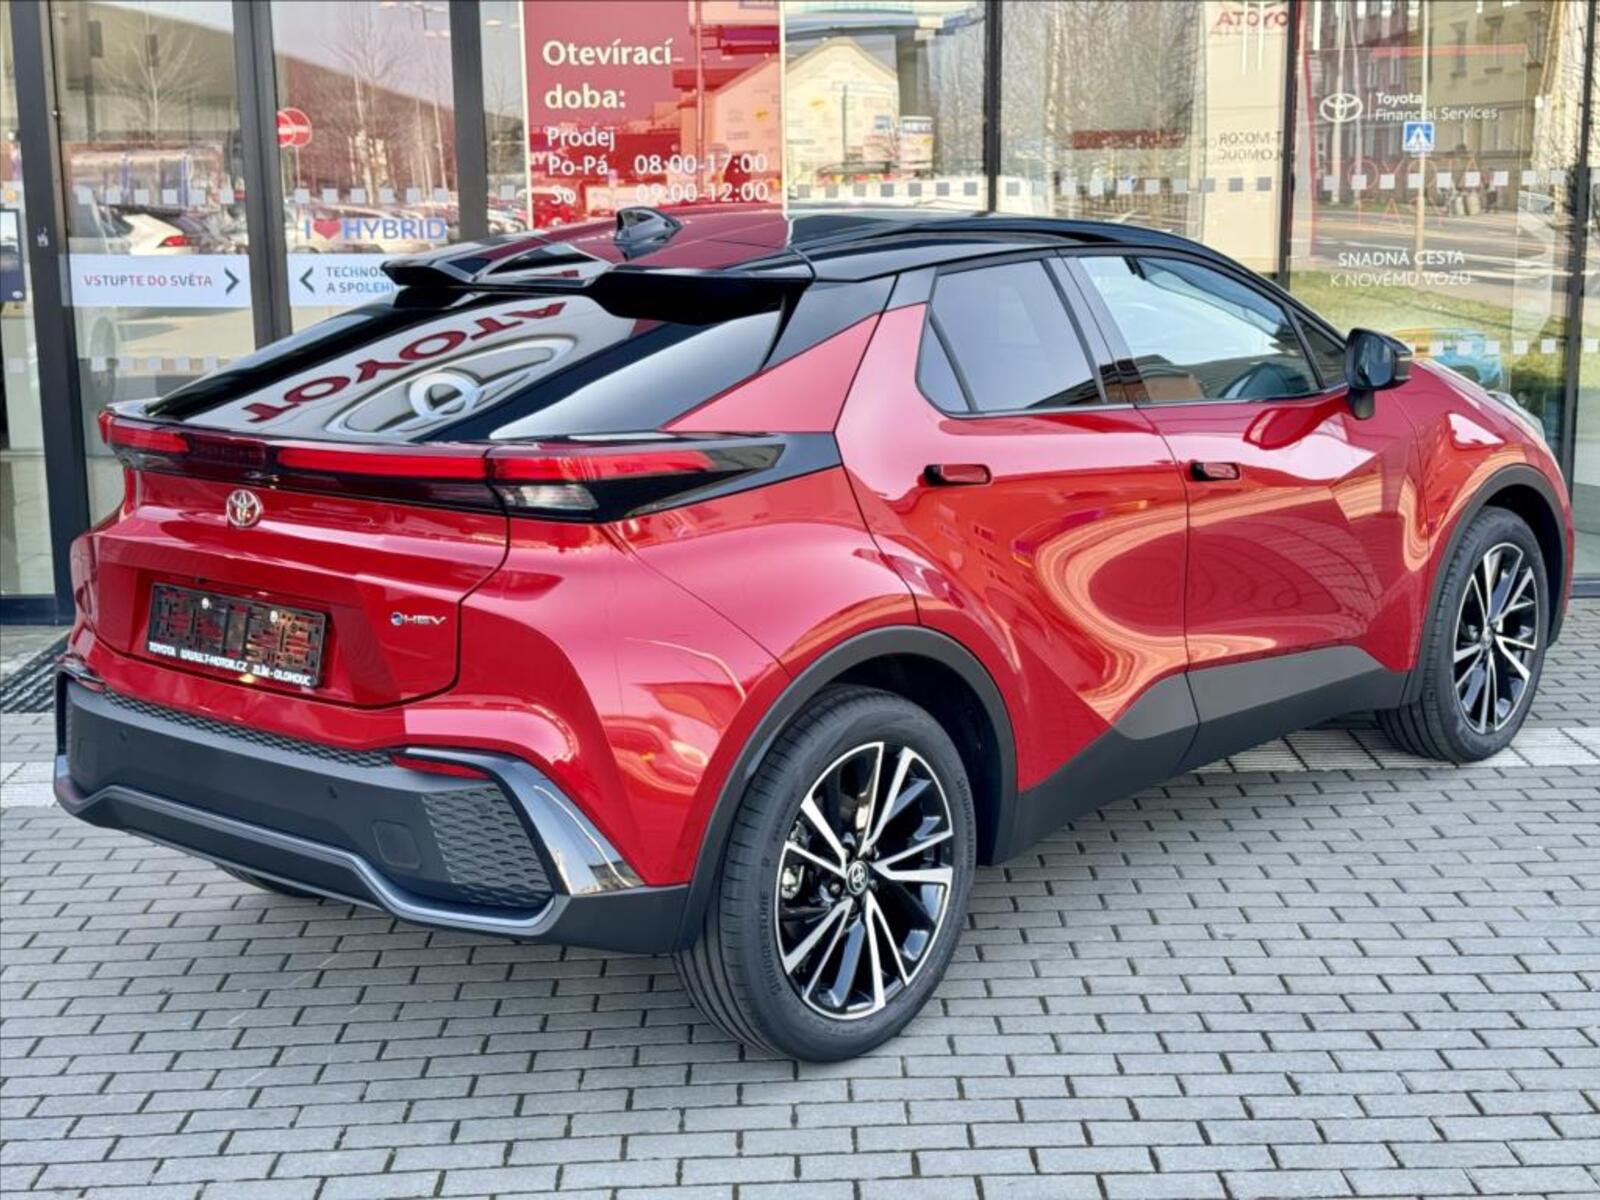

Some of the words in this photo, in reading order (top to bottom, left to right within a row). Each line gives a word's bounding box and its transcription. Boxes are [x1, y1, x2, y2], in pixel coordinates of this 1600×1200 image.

[542, 38, 673, 66] Otevírací
[544, 82, 626, 109] doba:
[1375, 92, 1424, 107] Toyota
[1441, 107, 1498, 120] Services
[547, 127, 615, 152] Prodej
[548, 154, 609, 175] Po-Pá
[634, 153, 768, 175] 08:00-17:00
[551, 185, 577, 205] So
[635, 182, 769, 203] 09:00-12:00
[343, 219, 447, 240] HYBRID
[1338, 248, 1410, 267] SNADNÁ
[1414, 250, 1465, 265] CESTA
[83, 274, 145, 287] VSTUPTE
[147, 275, 168, 287] DO
[326, 282, 336, 293] A
[1330, 274, 1341, 288] K
[1345, 269, 1420, 288] NOVÉMU
[1424, 271, 1472, 286] VOZU
[404, 613, 447, 625] HEV
